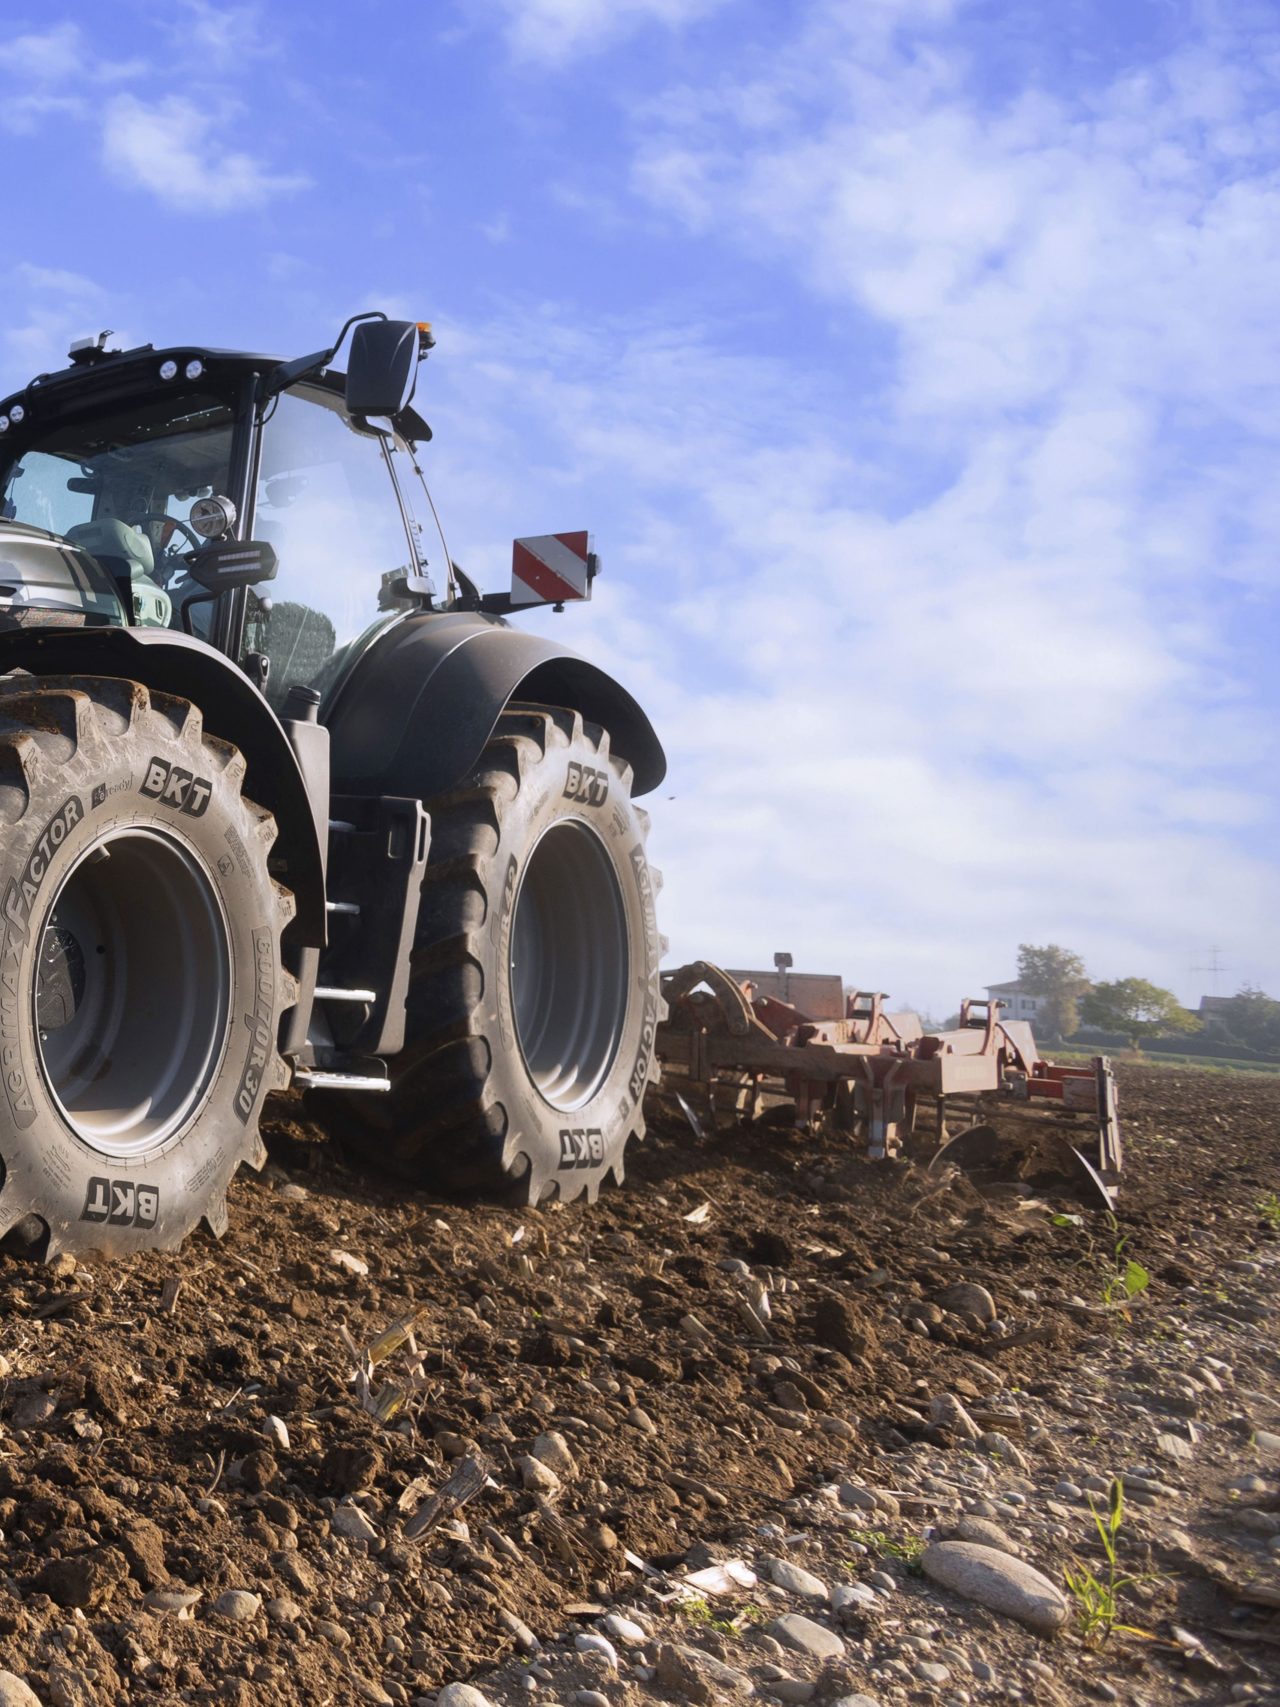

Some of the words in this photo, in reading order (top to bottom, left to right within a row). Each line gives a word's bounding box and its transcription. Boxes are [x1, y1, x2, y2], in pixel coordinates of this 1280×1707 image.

[143, 761, 211, 812] BKT
[565, 766, 609, 802] BKT
[560, 1133, 603, 1162] BKT
[86, 1183, 158, 1223] BKT
